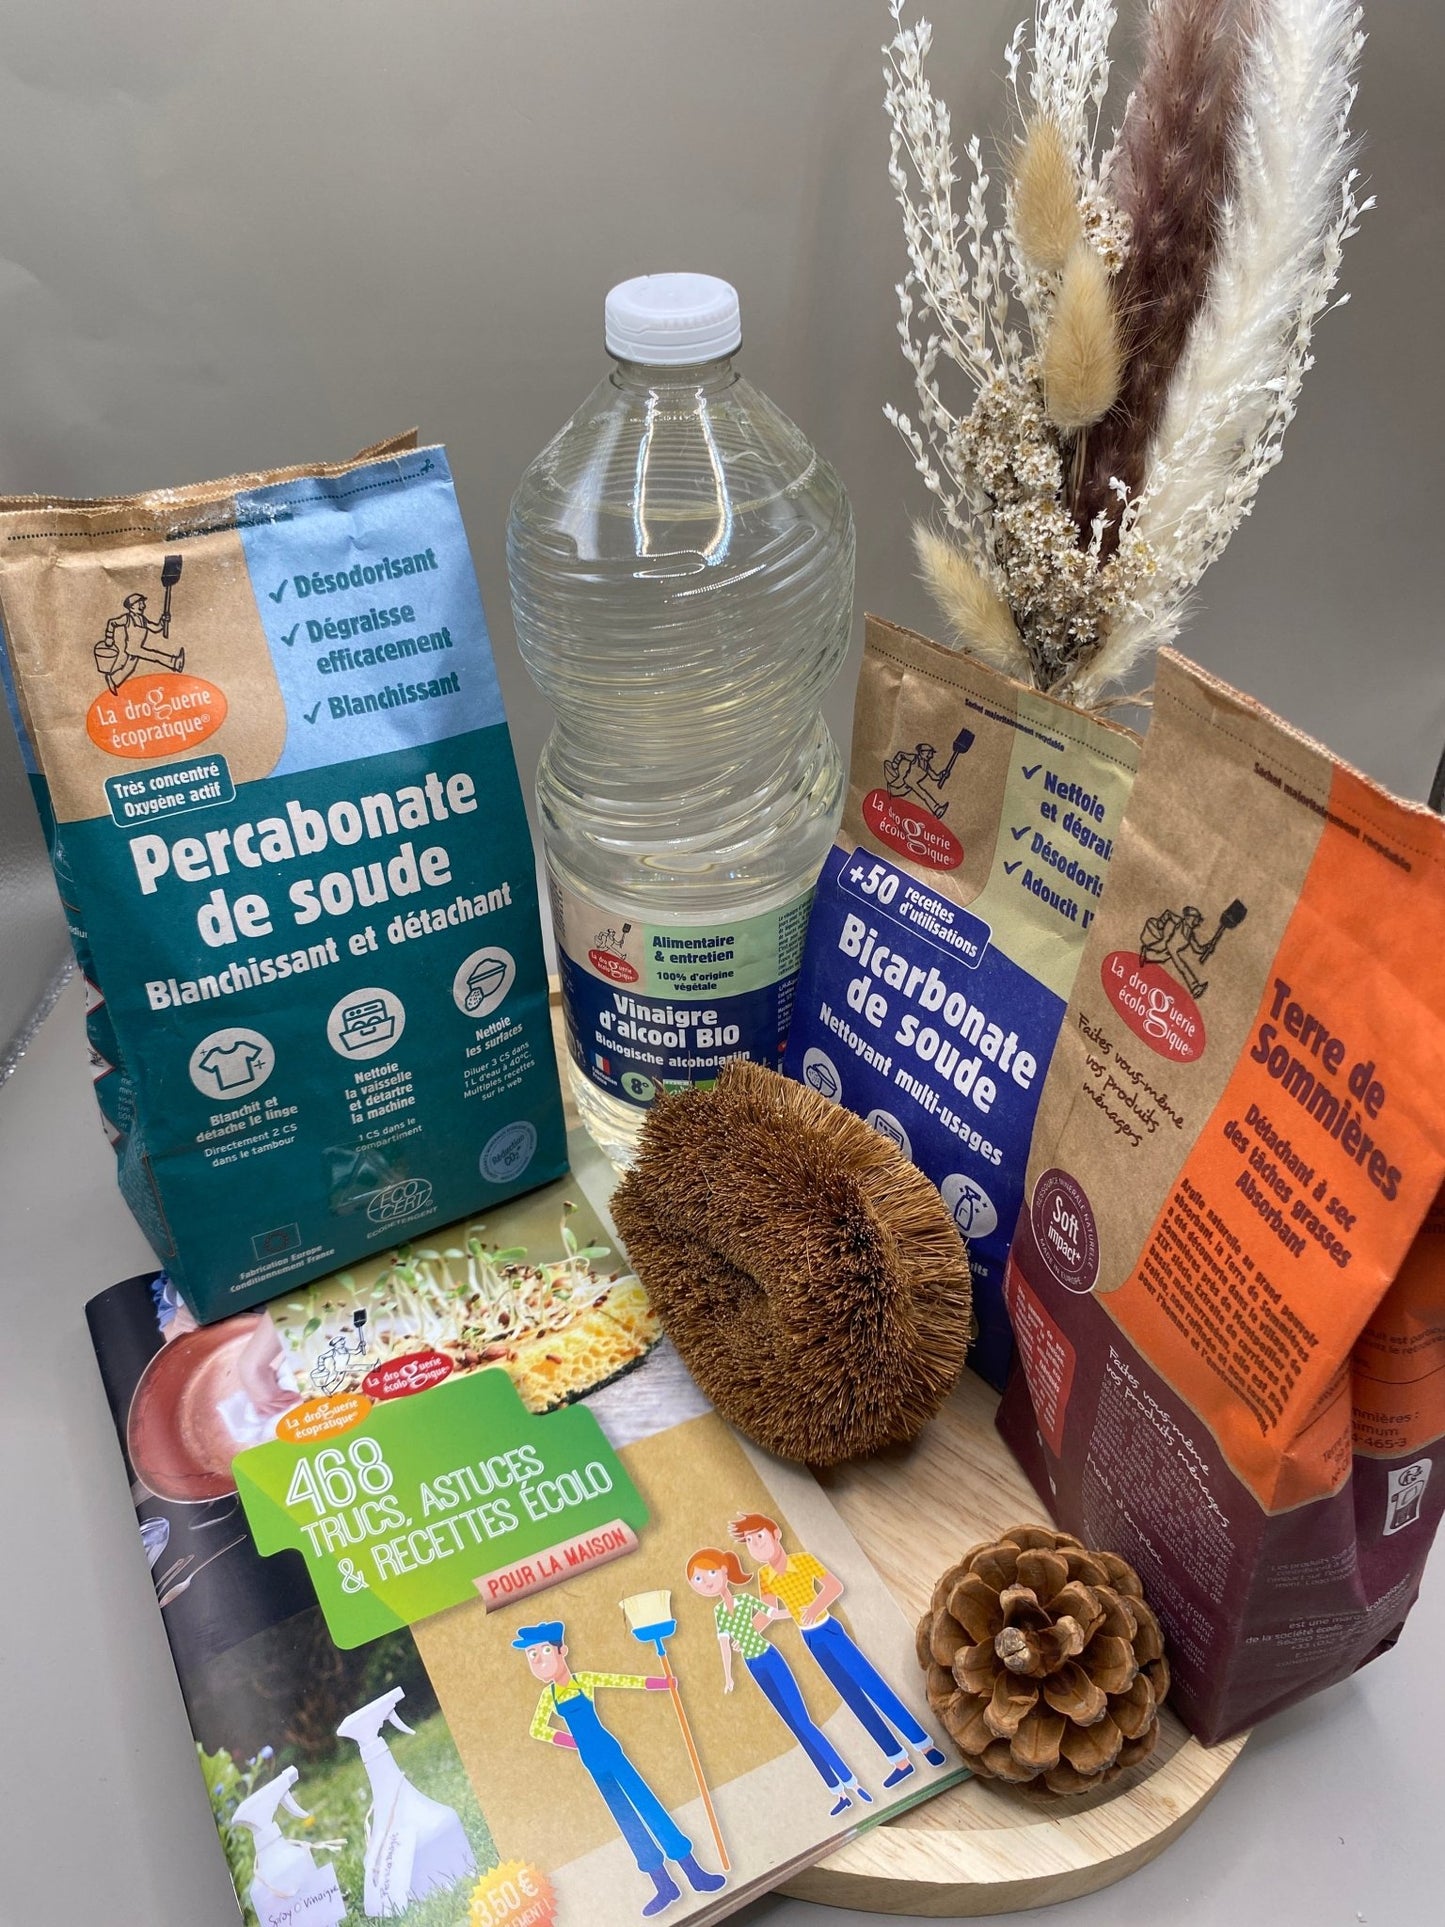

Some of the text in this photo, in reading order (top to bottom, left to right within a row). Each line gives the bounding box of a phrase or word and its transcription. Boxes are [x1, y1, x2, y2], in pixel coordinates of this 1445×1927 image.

[294, 548, 438, 597] Désodorisant
[306, 604, 415, 644] Dégraisse
[316, 627, 452, 675] efficacement
[97, 705, 118, 726] La
[327, 672, 461, 719] Blanchissant
[114, 762, 220, 799] Très concentré
[124, 782, 221, 817] Oxygène actif
[1044, 771, 1106, 824] Nettoie
[872, 793, 884, 812] La
[129, 772, 478, 895] Percabonate
[1040, 801, 1114, 862] et dégrai
[197, 842, 452, 947] de soude
[848, 863, 900, 906] +50
[1021, 869, 1078, 922] Adoucit
[904, 886, 955, 925] recettes
[145, 936, 340, 1011] Blanchissant
[348, 926, 379, 956] et
[387, 881, 513, 946] détachant
[652, 934, 735, 949] Alimentaire
[899, 901, 978, 959] d'utilisations
[654, 950, 734, 964] & entretien
[656, 970, 735, 984] 100% d'origine
[1111, 956, 1124, 978] La
[674, 981, 717, 992] végétale
[838, 912, 1039, 1090] Bicarbonate
[475, 1016, 511, 1041] Nettoie
[599, 1010, 740, 1048] d'alcool BIO
[613, 992, 718, 1028] Vinaigre
[466, 1023, 523, 1058] les surfaces
[595, 1031, 664, 1066] Biologische
[846, 975, 888, 1028] de
[895, 1014, 998, 1114] soude
[1270, 977, 1385, 1120] Terre de
[354, 1062, 399, 1084] Nettoie
[464, 1062, 489, 1078] Diluer
[500, 1051, 510, 1062] CS
[464, 1059, 535, 1099] Multiples recettes
[818, 1002, 893, 1076] Nettoyant
[894, 1067, 1004, 1167] multi-usages
[1078, 1013, 1185, 1130] Faites vous-même
[345, 1071, 412, 1100] la vaisselle
[349, 1083, 414, 1112] et détartre
[481, 1090, 495, 1100] sur
[1085, 1054, 1160, 1133] vos produits
[196, 1105, 299, 1143] détache le linge
[210, 1096, 278, 1126] Blanchit et
[351, 1095, 416, 1125] la machine
[366, 1130, 380, 1139] CS
[382, 1121, 406, 1135] dans
[1082, 1082, 1143, 1147] ménagers
[1250, 1023, 1402, 1202] Sommières
[204, 1123, 297, 1157] Directement 2 CS
[212, 1136, 295, 1167] dans le tambour
[355, 1125, 423, 1153] compartiment
[1244, 1103, 1357, 1233] Détachant à sec
[379, 1181, 418, 1209] ECO
[380, 1190, 425, 1219] CERT
[1223, 1119, 1352, 1269] des tâches grasses
[1053, 1195, 1079, 1245] Soft
[1235, 1170, 1307, 1259] Absorbant
[1181, 1178, 1205, 1210] Argile
[1206, 1209, 1242, 1256] naturelle
[1242, 1255, 1255, 1272] au
[1255, 1272, 1282, 1305] grand
[230, 1248, 335, 1293] Conditionnement France
[239, 1245, 323, 1280] Fabrication Europe
[1224, 1253, 1246, 1285] Terre
[1247, 1284, 1259, 1302] de
[367, 1377, 380, 1388] La
[1109, 1345, 1140, 1389] Faites
[285, 1418, 299, 1430] La
[1106, 1363, 1122, 1386] vos
[1125, 1386, 1174, 1446] produits
[1177, 1449, 1230, 1528] ménagers
[285, 1437, 395, 1516] 468
[300, 1444, 545, 1559] TRUCS, ASTUCES
[338, 1461, 614, 1595] & RECETTES ÉCOLO
[487, 1528, 629, 1599] POUR LA MAISON
[518, 1869, 539, 1897] €
